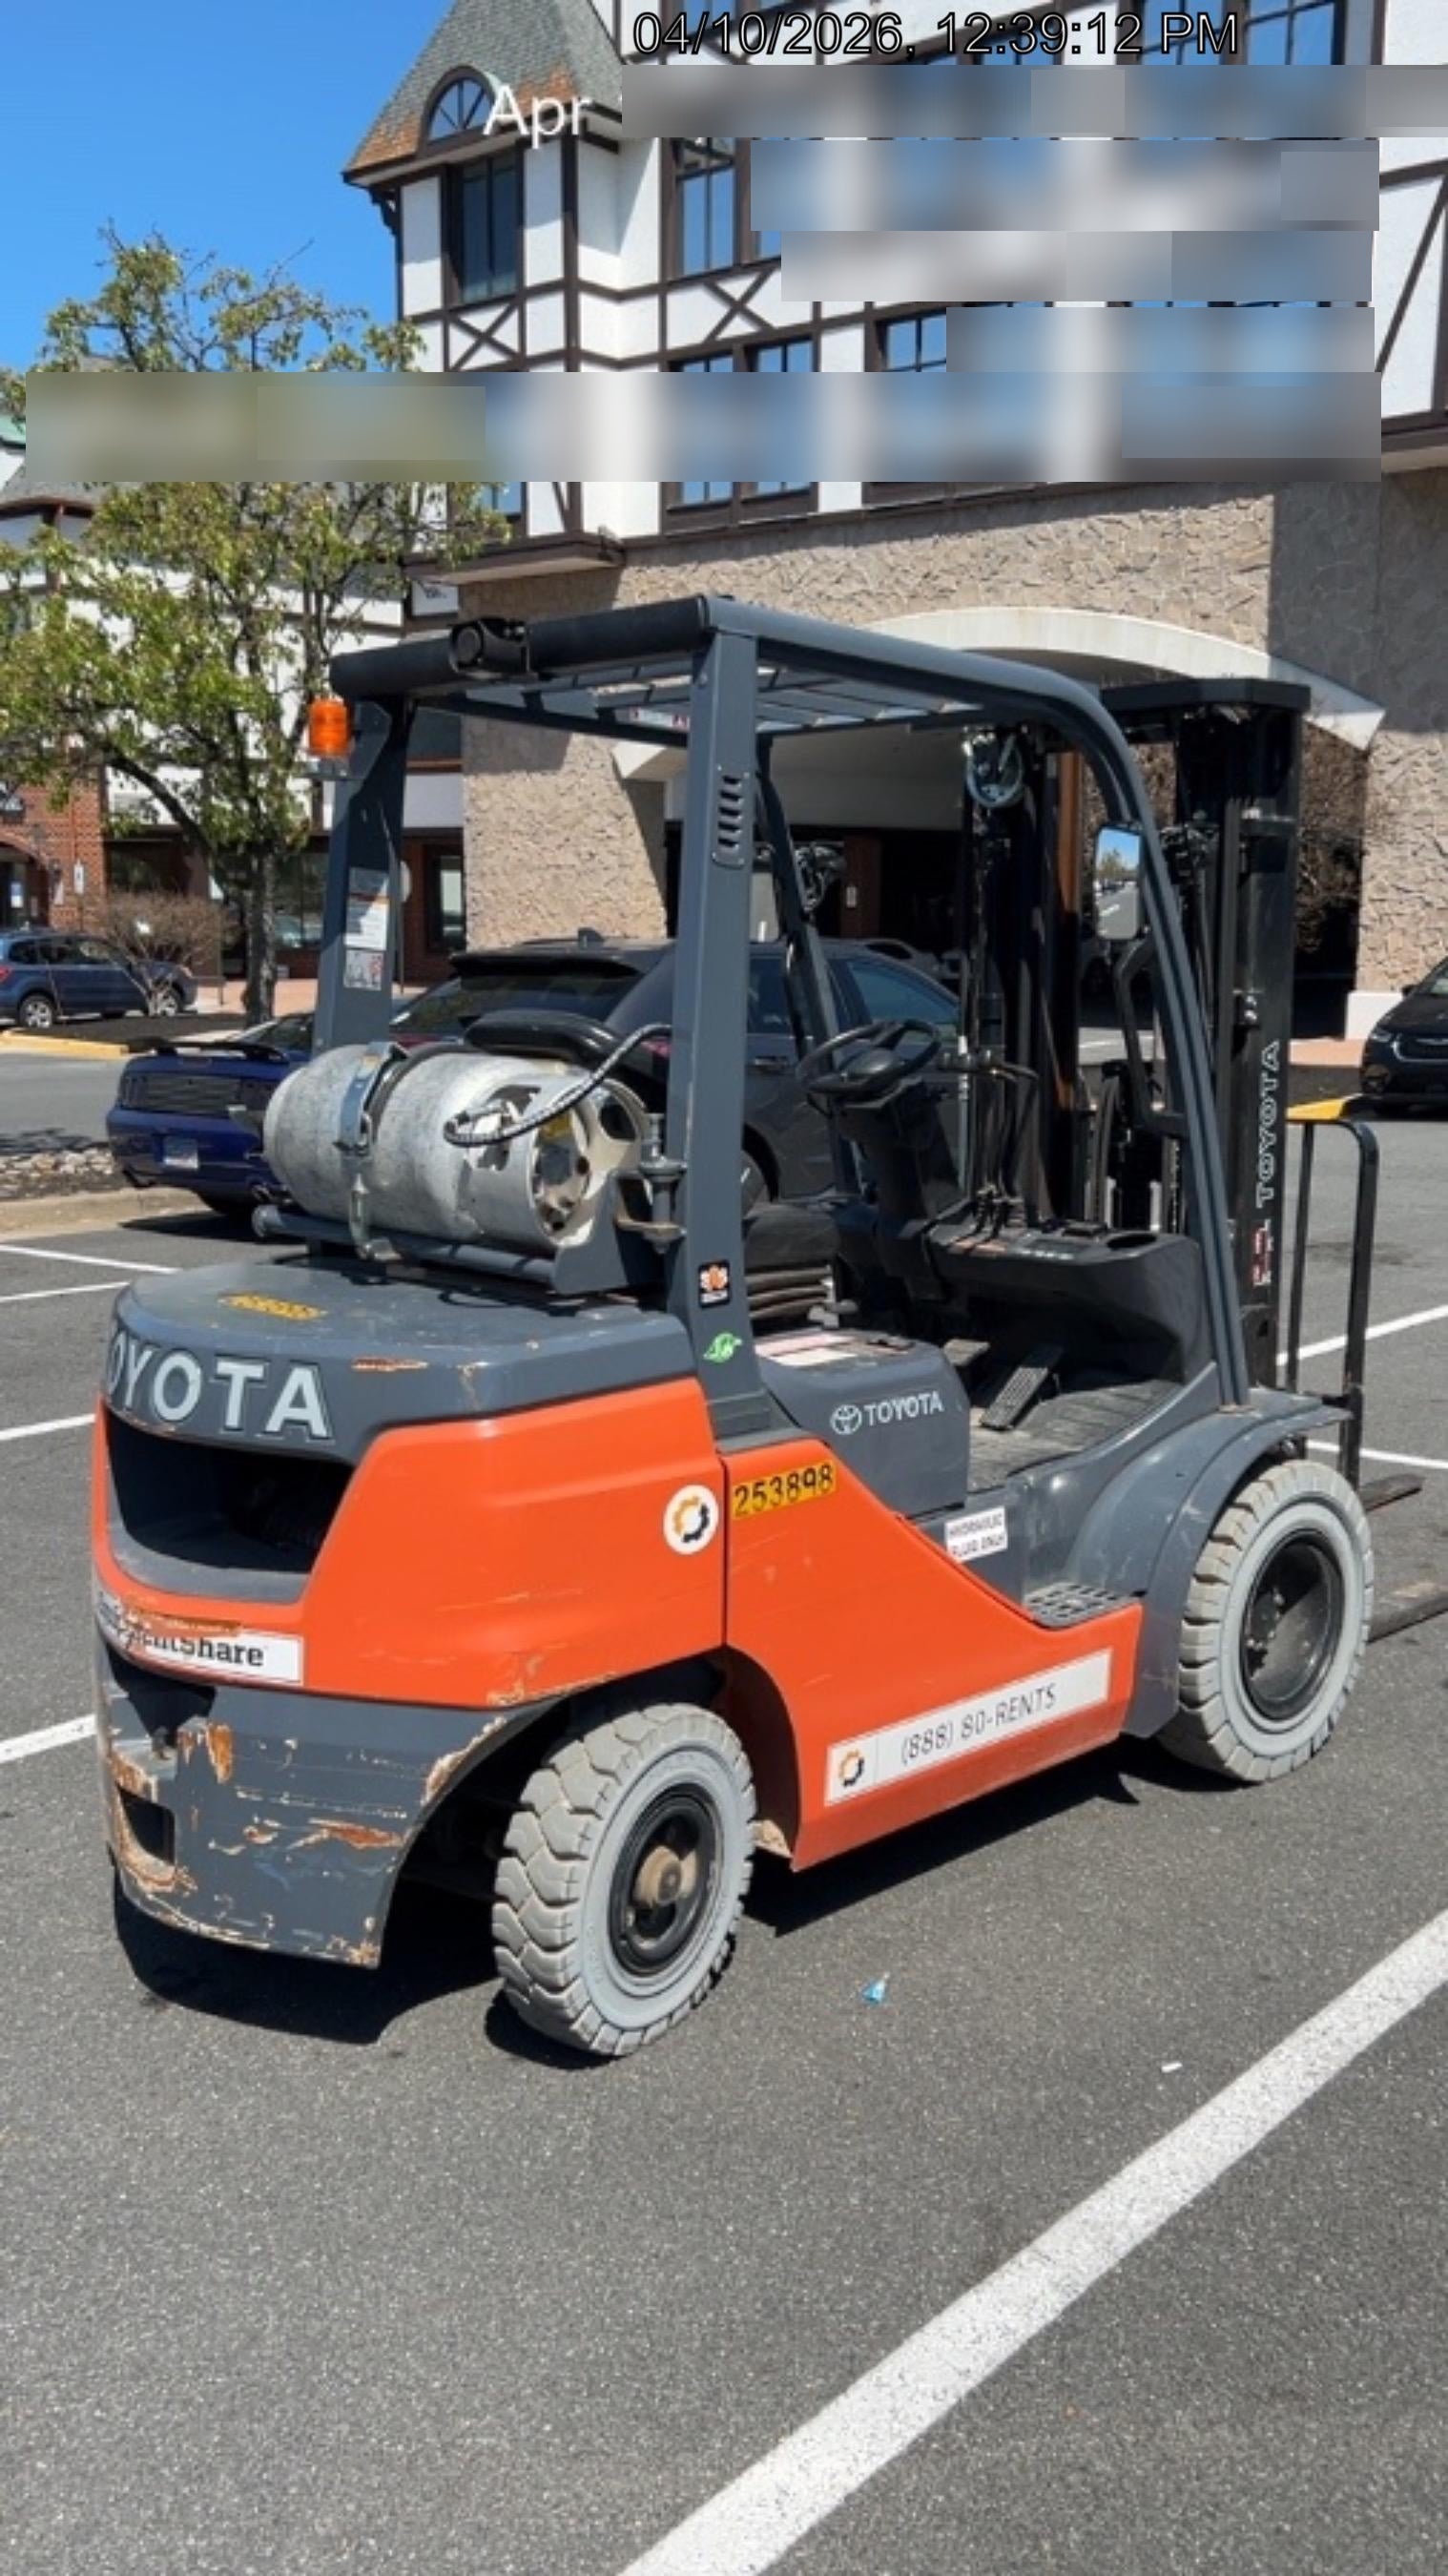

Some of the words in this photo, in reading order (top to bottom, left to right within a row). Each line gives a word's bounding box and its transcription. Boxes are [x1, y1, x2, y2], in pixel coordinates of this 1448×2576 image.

[1256, 1040, 1280, 1209] TOYOTA
[109, 1332, 330, 1439] OYOTA
[864, 1391, 944, 1426] TOYOTA
[734, 1464, 834, 1516] 253898
[901, 1720, 954, 1766] (888)
[961, 1683, 1057, 1739] 80-RENTS
